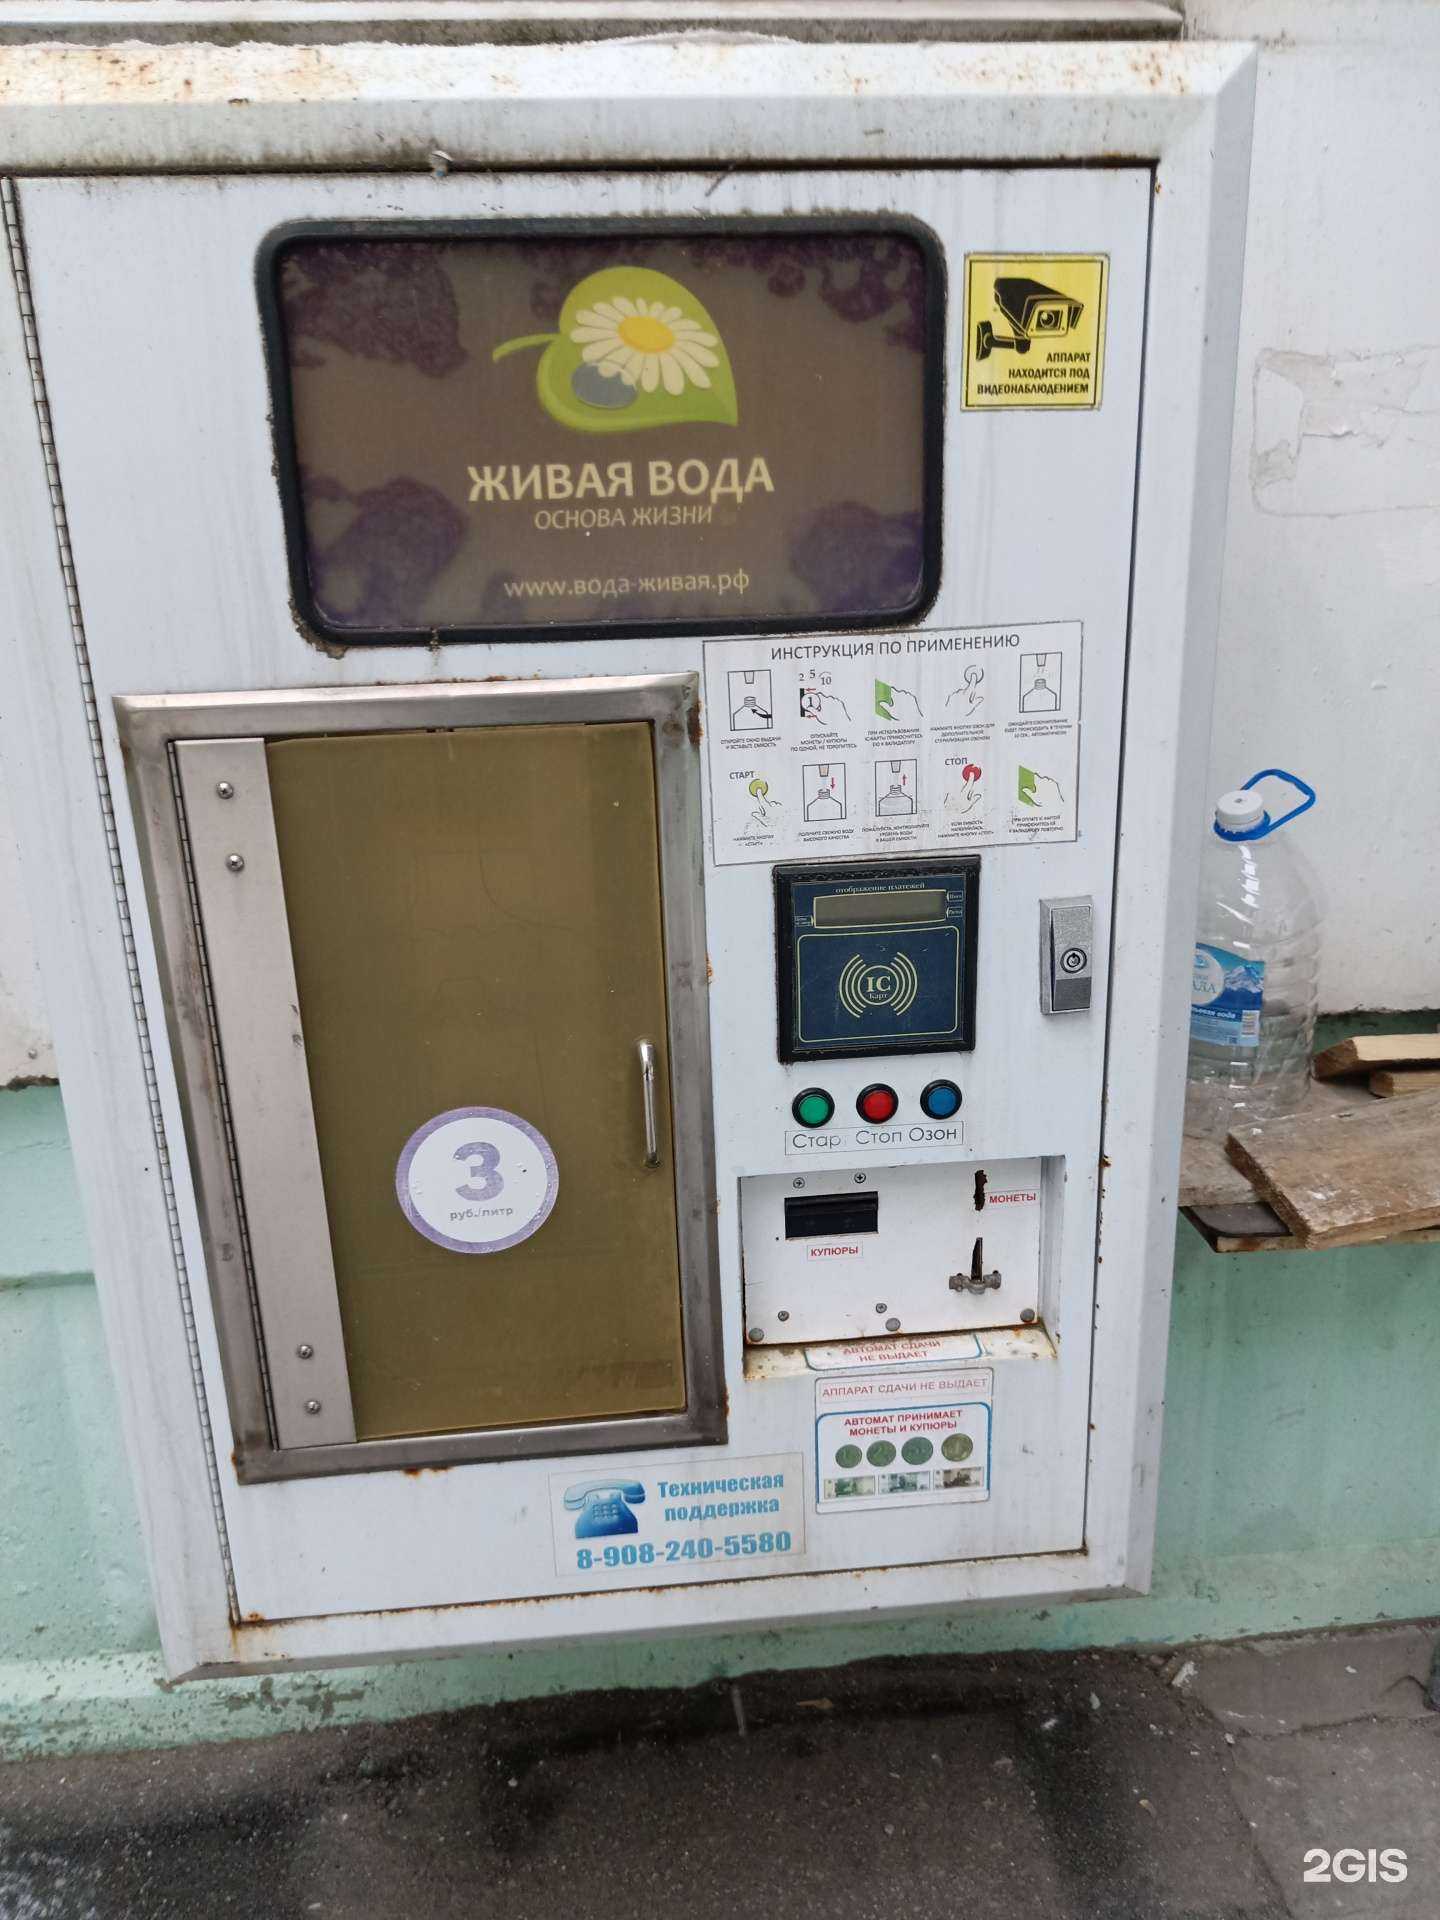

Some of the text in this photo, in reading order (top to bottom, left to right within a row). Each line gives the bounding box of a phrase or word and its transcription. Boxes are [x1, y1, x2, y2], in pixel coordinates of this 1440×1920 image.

[1047, 352, 1091, 363] АППАРАТ
[1008, 367, 1090, 380] НАХОДИТСЯ ПОД
[977, 383, 1089, 396] ВИДЕОНАБЛЮДЕНИЕМ
[467, 456, 775, 502] ЖИВАЯ ВОДА
[534, 504, 712, 531] ОСНОВА ЖИЗНИ
[503, 569, 751, 600] www.вода-живая.рф
[771, 633, 1020, 660] ИНСТРУКЦИЯ ПО ПРИМЕНЕНИЮ
[820, 676, 832, 685] 10
[944, 757, 968, 766] СТОП
[729, 770, 756, 780] СТАРТ
[866, 976, 891, 992] IC
[792, 1127, 957, 1149] Стар Стоп Озон
[453, 1142, 505, 1201] 3
[989, 1193, 1037, 1204] МОНЕТЫ
[810, 1245, 859, 1258] КУПЮРЫ
[843, 1340, 941, 1355] АВТОМАТ СДАЧИ
[859, 1350, 928, 1363] НЕ ВЫДАЕТ
[822, 1377, 988, 1398] АППАРАТ СДАЧИ НЕ ВЫДАЕТ
[844, 1409, 963, 1427] АВТОМАТ ПРИНИМАЕТ
[849, 1420, 958, 1437] МОНЕТЫ И КУПЮРЫ
[657, 1473, 784, 1498] Техническая
[664, 1498, 780, 1522] поддержка
[576, 1530, 792, 1571] 8-908-240-5580
